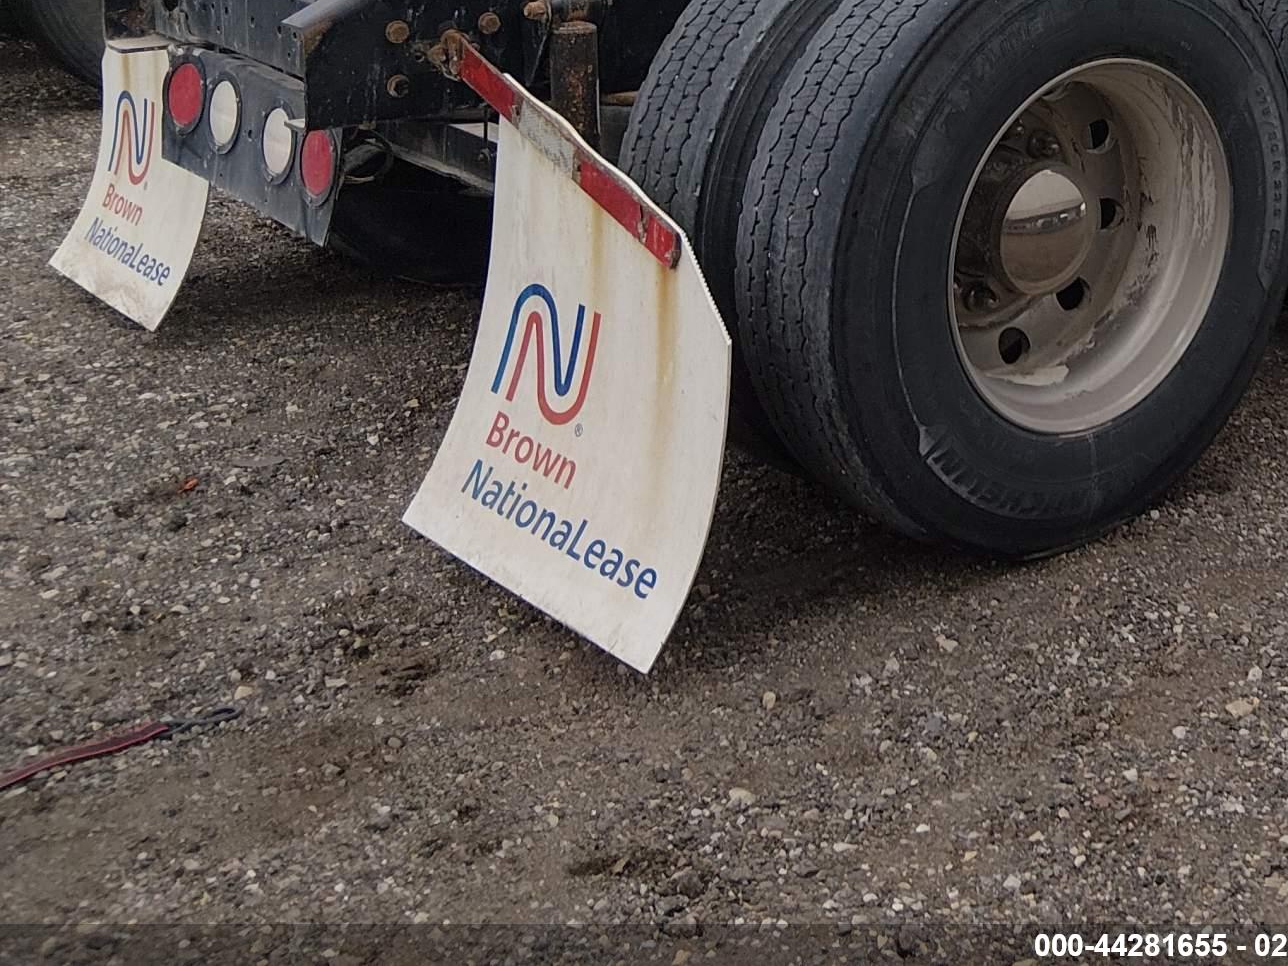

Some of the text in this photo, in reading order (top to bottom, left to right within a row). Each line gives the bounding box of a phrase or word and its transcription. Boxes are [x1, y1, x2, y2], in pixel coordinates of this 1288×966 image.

[102, 183, 143, 226] Brown
[85, 217, 171, 286] NationaLease
[485, 411, 577, 490] Brown
[461, 459, 658, 599] NationaLease
